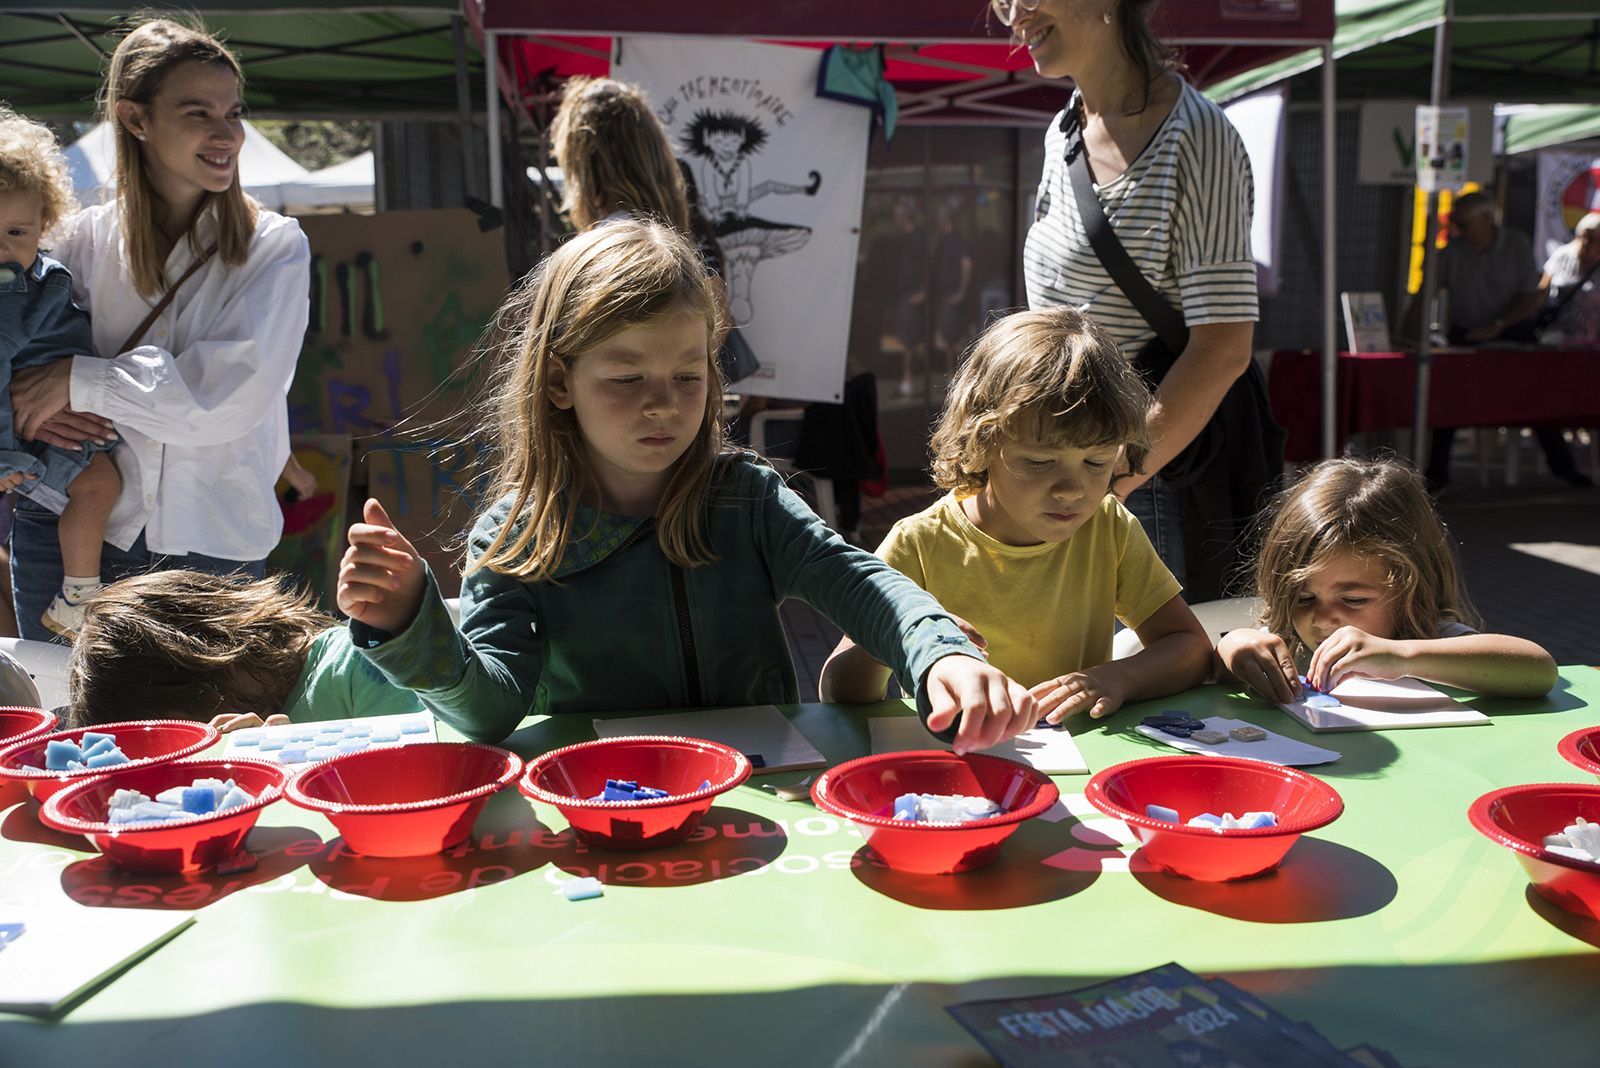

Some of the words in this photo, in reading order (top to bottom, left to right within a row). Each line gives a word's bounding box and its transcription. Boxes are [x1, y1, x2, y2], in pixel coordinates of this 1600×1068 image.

[418, 865, 515, 902] de
[997, 1007, 1093, 1037] FESTA
[1083, 986, 1181, 1029] MAJOR
[1174, 1003, 1240, 1037] 2024
